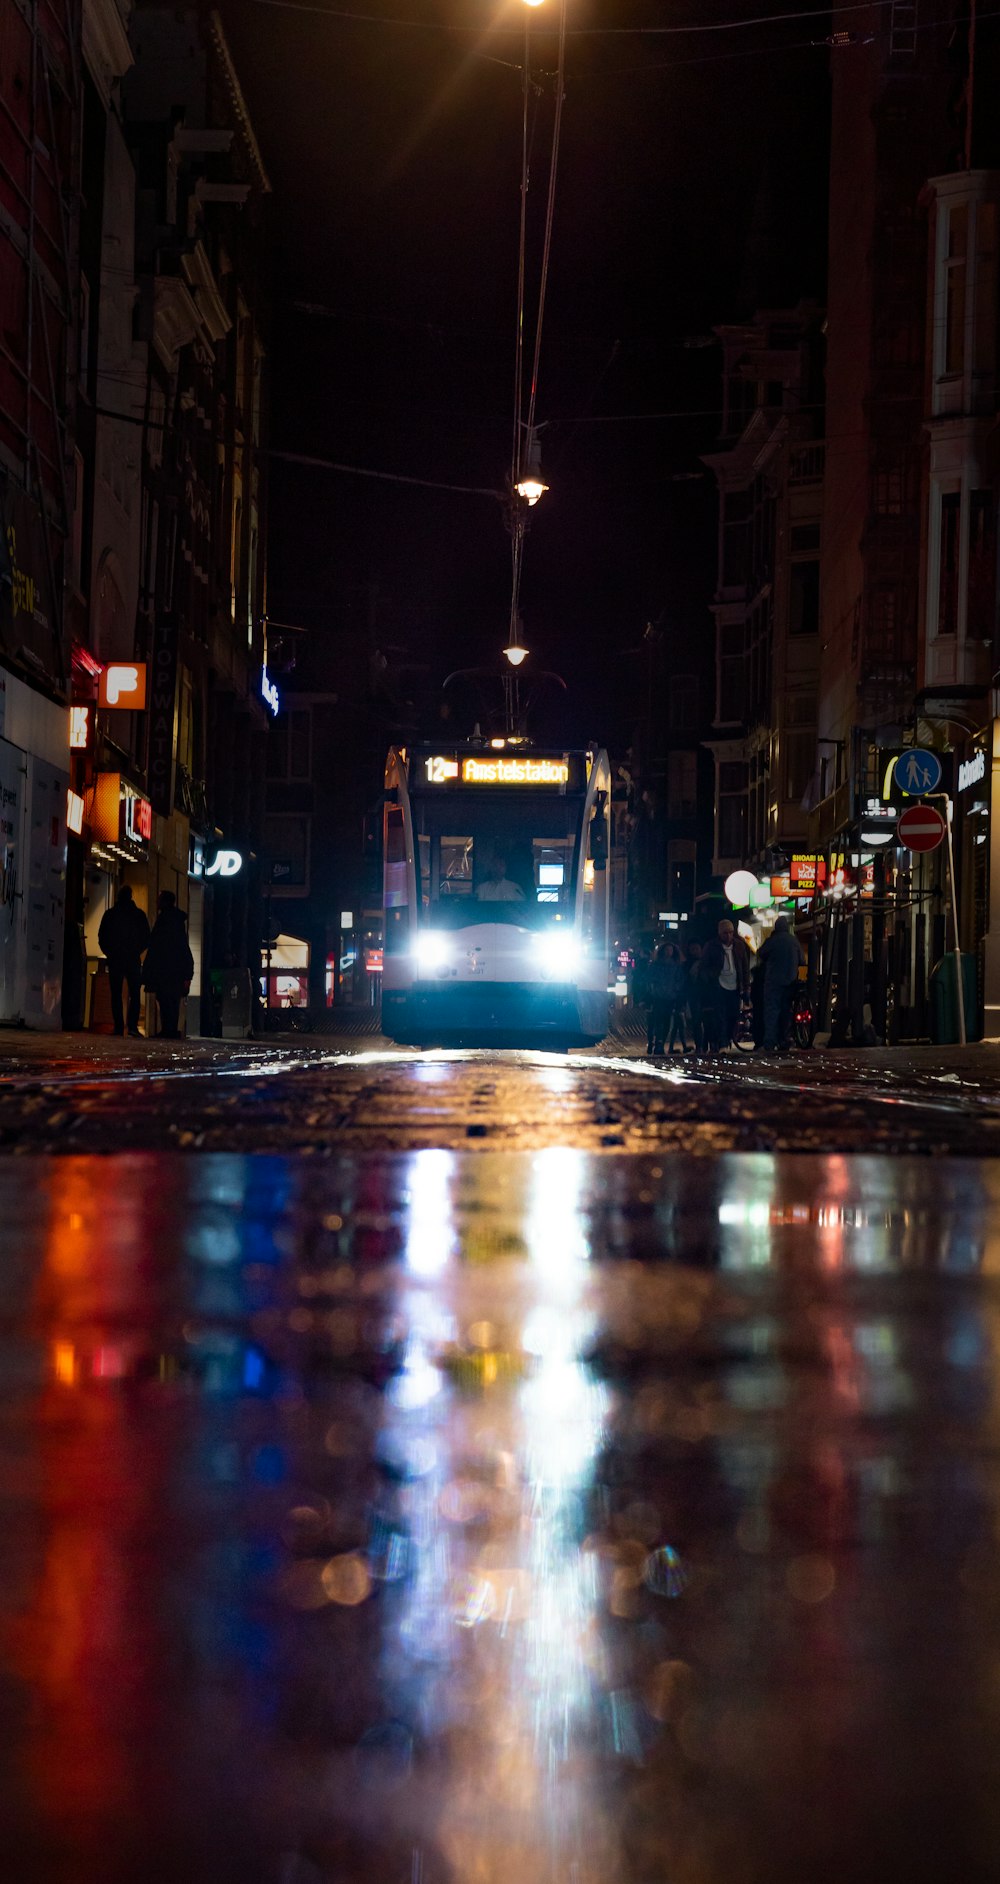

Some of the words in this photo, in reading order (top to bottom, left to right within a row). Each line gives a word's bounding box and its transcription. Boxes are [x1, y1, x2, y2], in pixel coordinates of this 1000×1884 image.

[107, 667, 138, 704] F
[153, 627, 173, 796] TOPWATCH
[425, 757, 445, 782] 12
[465, 759, 569, 782] Amstelstation
[206, 851, 242, 875] JD
